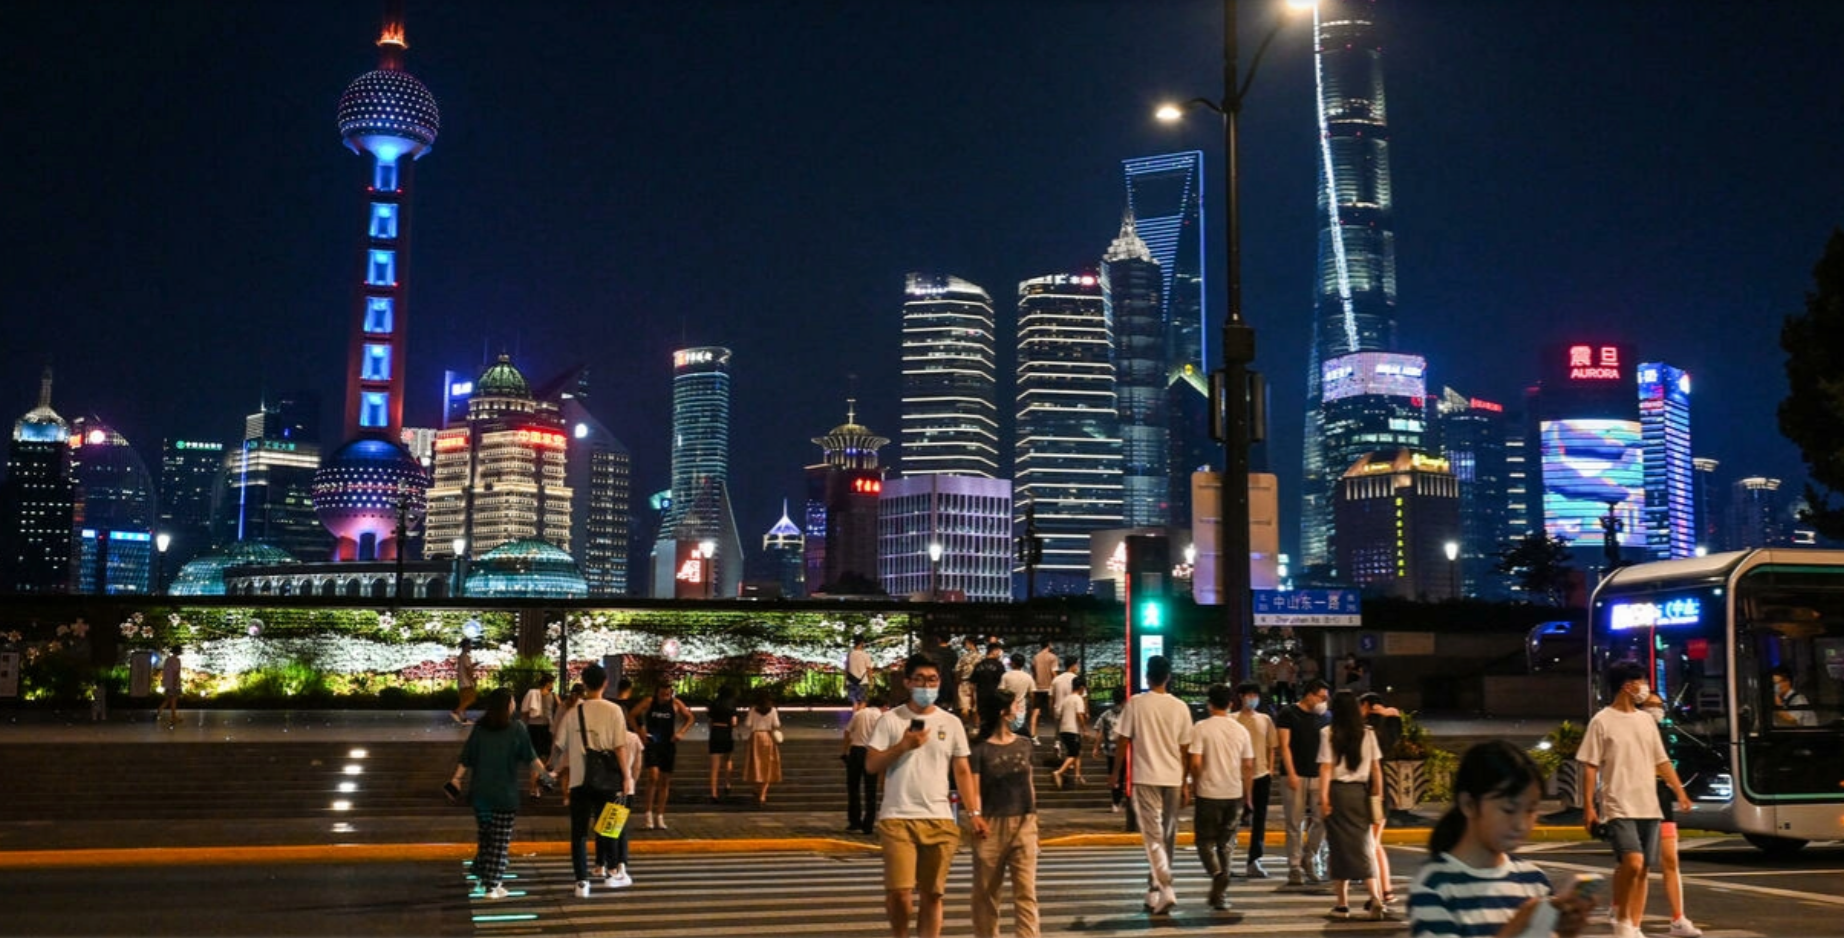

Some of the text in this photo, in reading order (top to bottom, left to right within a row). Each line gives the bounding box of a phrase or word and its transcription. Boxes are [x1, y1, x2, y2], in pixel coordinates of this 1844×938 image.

[1570, 345, 1619, 366] 震旦
[1570, 368, 1620, 379] AURORA
[1272, 594, 1340, 610] 中山东一路
